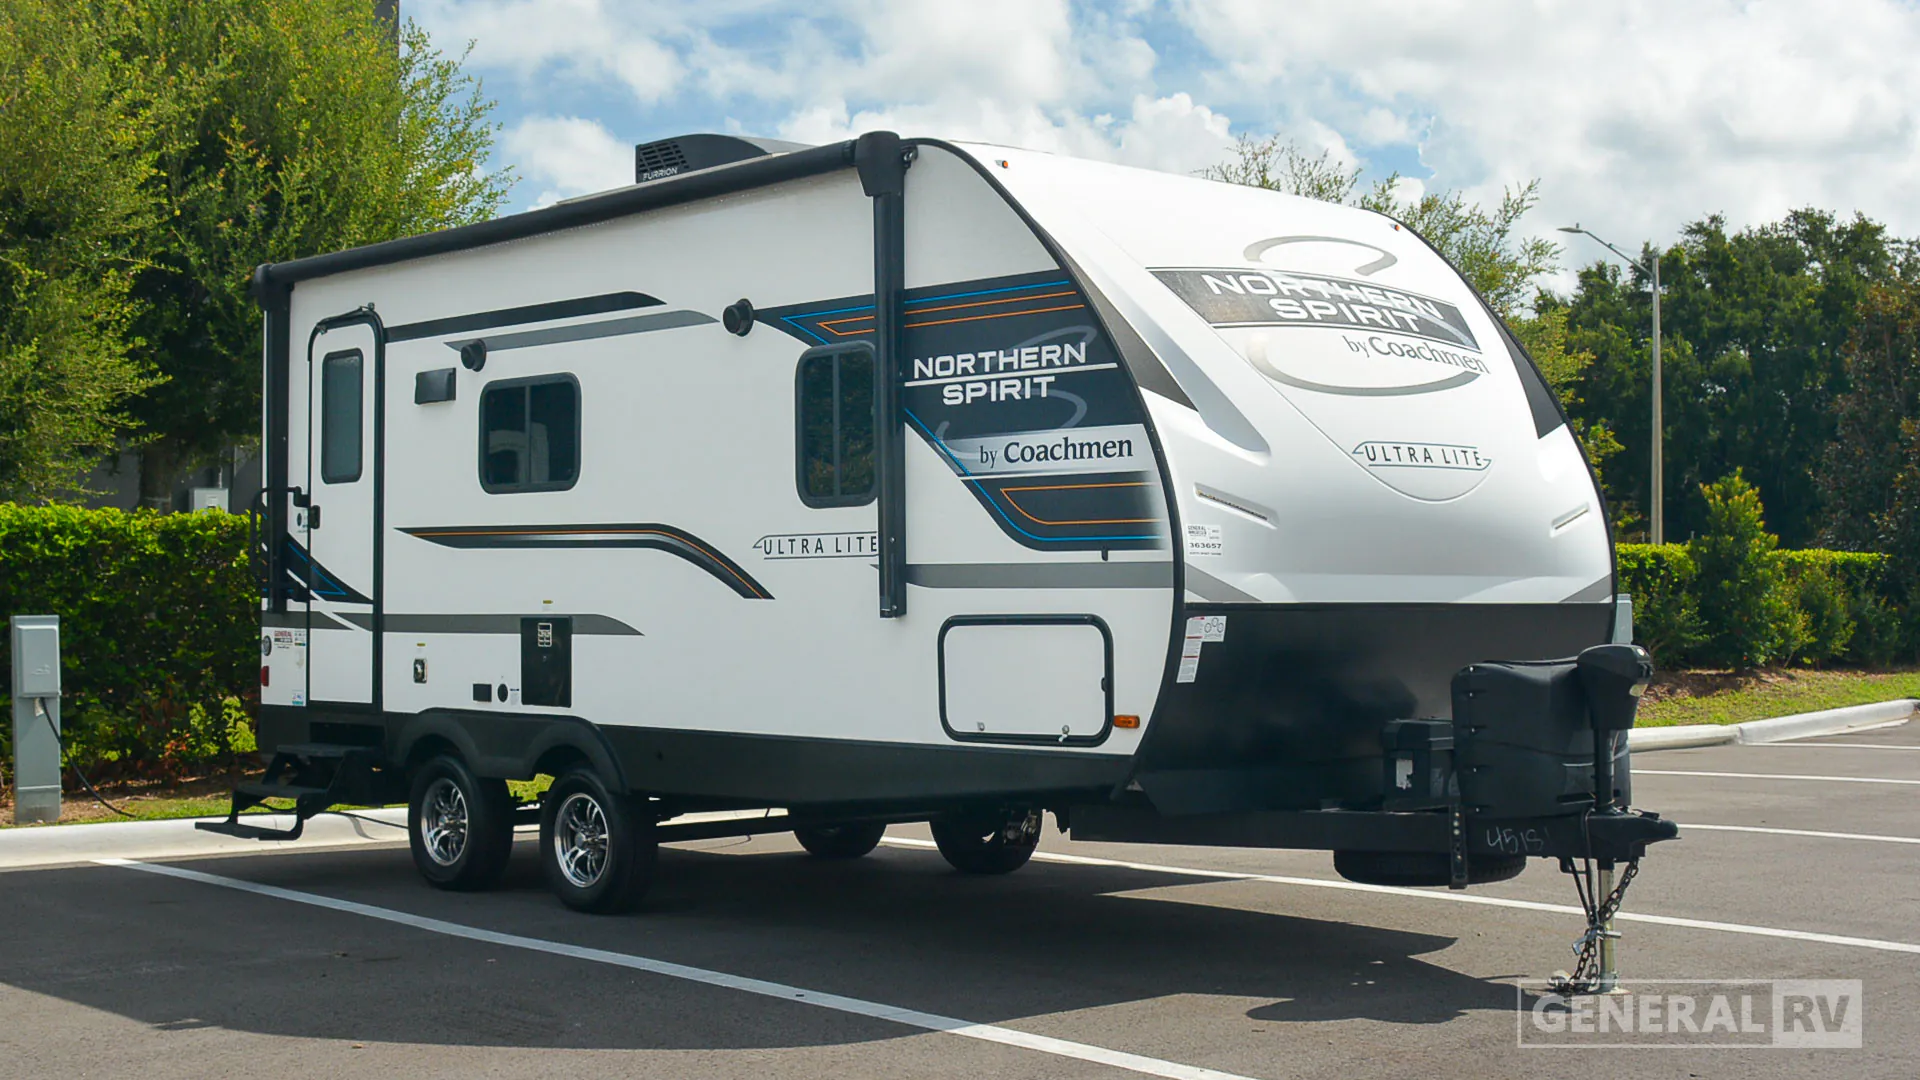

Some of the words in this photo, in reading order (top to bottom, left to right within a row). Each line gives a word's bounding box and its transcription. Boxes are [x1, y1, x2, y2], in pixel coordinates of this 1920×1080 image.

[1201, 274, 1444, 320] NORTHERN
[1268, 298, 1422, 333] SPIRIT
[913, 341, 1087, 379] NORTHERN
[1342, 335, 1369, 358] by
[1368, 336, 1491, 375] Coachmen
[942, 376, 1056, 406] SPIRIT
[979, 445, 998, 468] by
[1003, 436, 1134, 464] Coachmen
[1364, 445, 1431, 464] ULTRA
[1444, 448, 1483, 467] LITE
[763, 537, 824, 555] ULTRA
[835, 535, 878, 553] LITE
